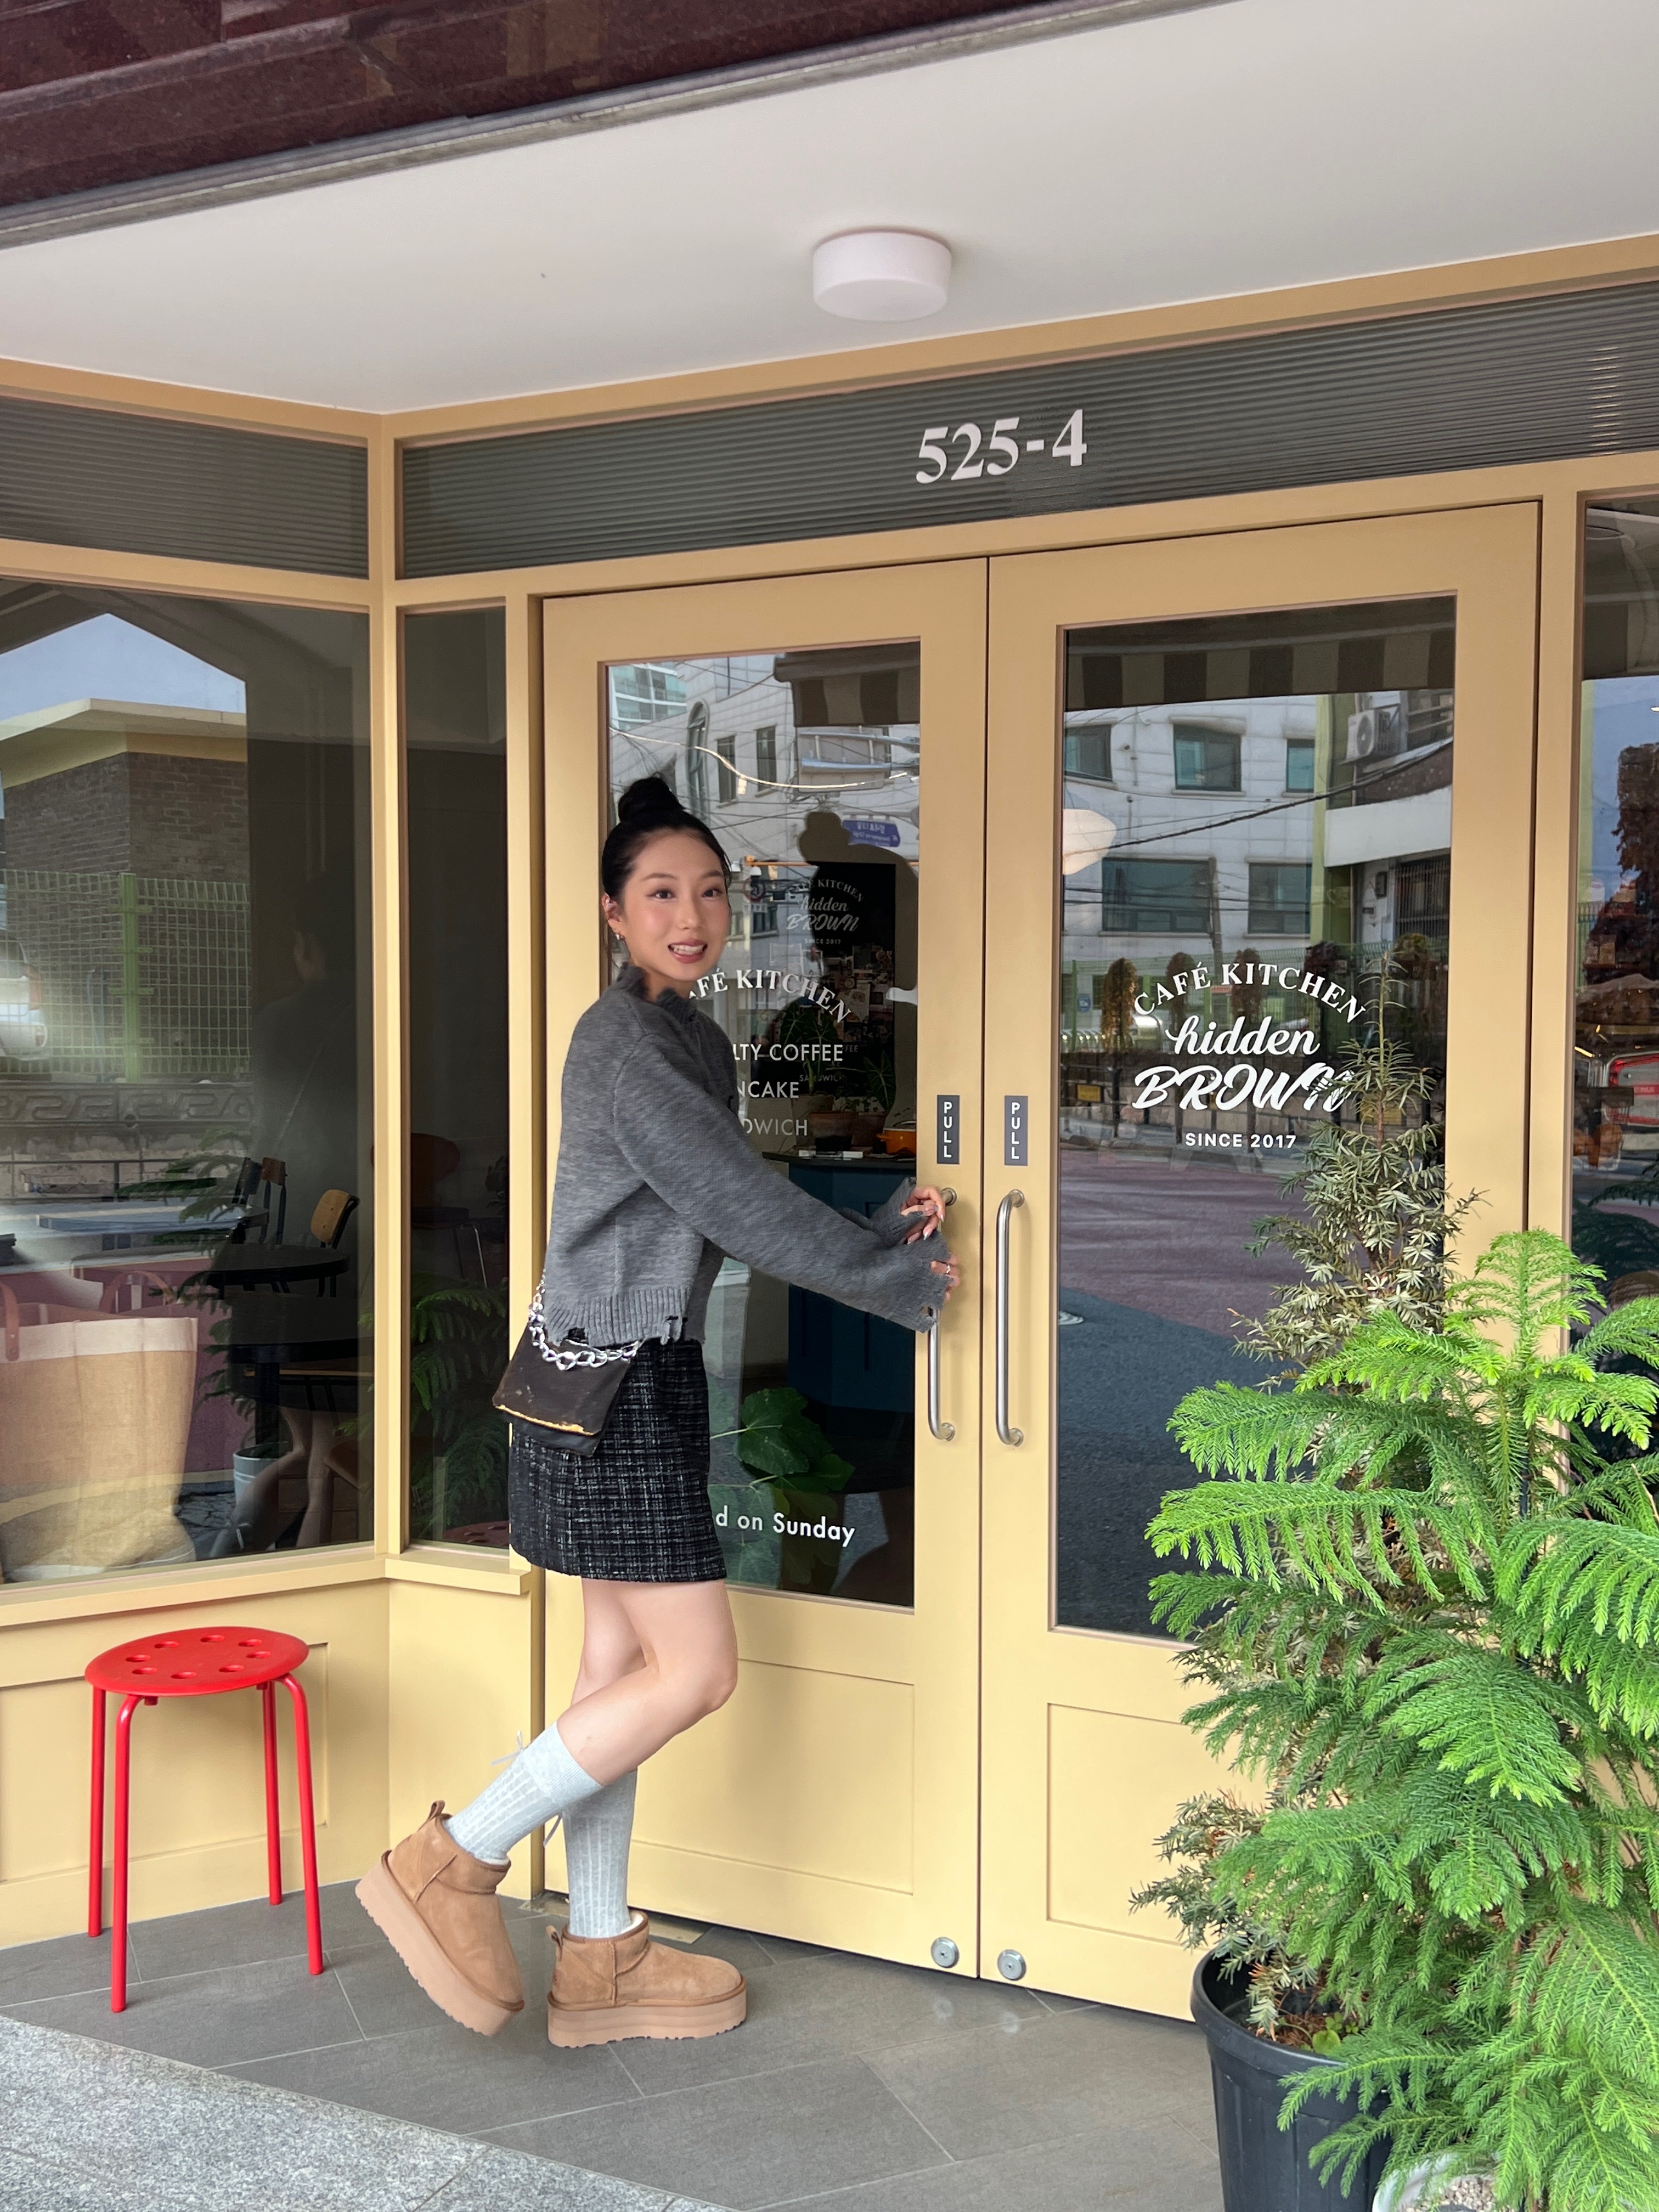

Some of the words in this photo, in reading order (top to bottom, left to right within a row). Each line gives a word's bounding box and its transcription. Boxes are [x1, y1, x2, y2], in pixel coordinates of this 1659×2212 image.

[916, 409, 1087, 484] 525-4
[689, 967, 729, 999] FÉ
[736, 969, 851, 1023] KITCHEN
[1133, 961, 1212, 1017] CAFÉ
[1222, 962, 1367, 1023] KITCHEN
[769, 1043, 843, 1062] COFFEE
[1165, 1015, 1321, 1056] hidden
[737, 1081, 799, 1099] NCAKE
[1132, 1062, 1355, 1113] BROWN
[742, 1118, 808, 1136] DWICH
[944, 1101, 953, 1158] PULL
[1011, 1102, 1020, 1160] PULL
[1185, 1132, 1243, 1148] SINCE
[1250, 1133, 1297, 1149] 2017
[737, 1515, 763, 1531] on
[772, 1512, 855, 1548] Sunday
